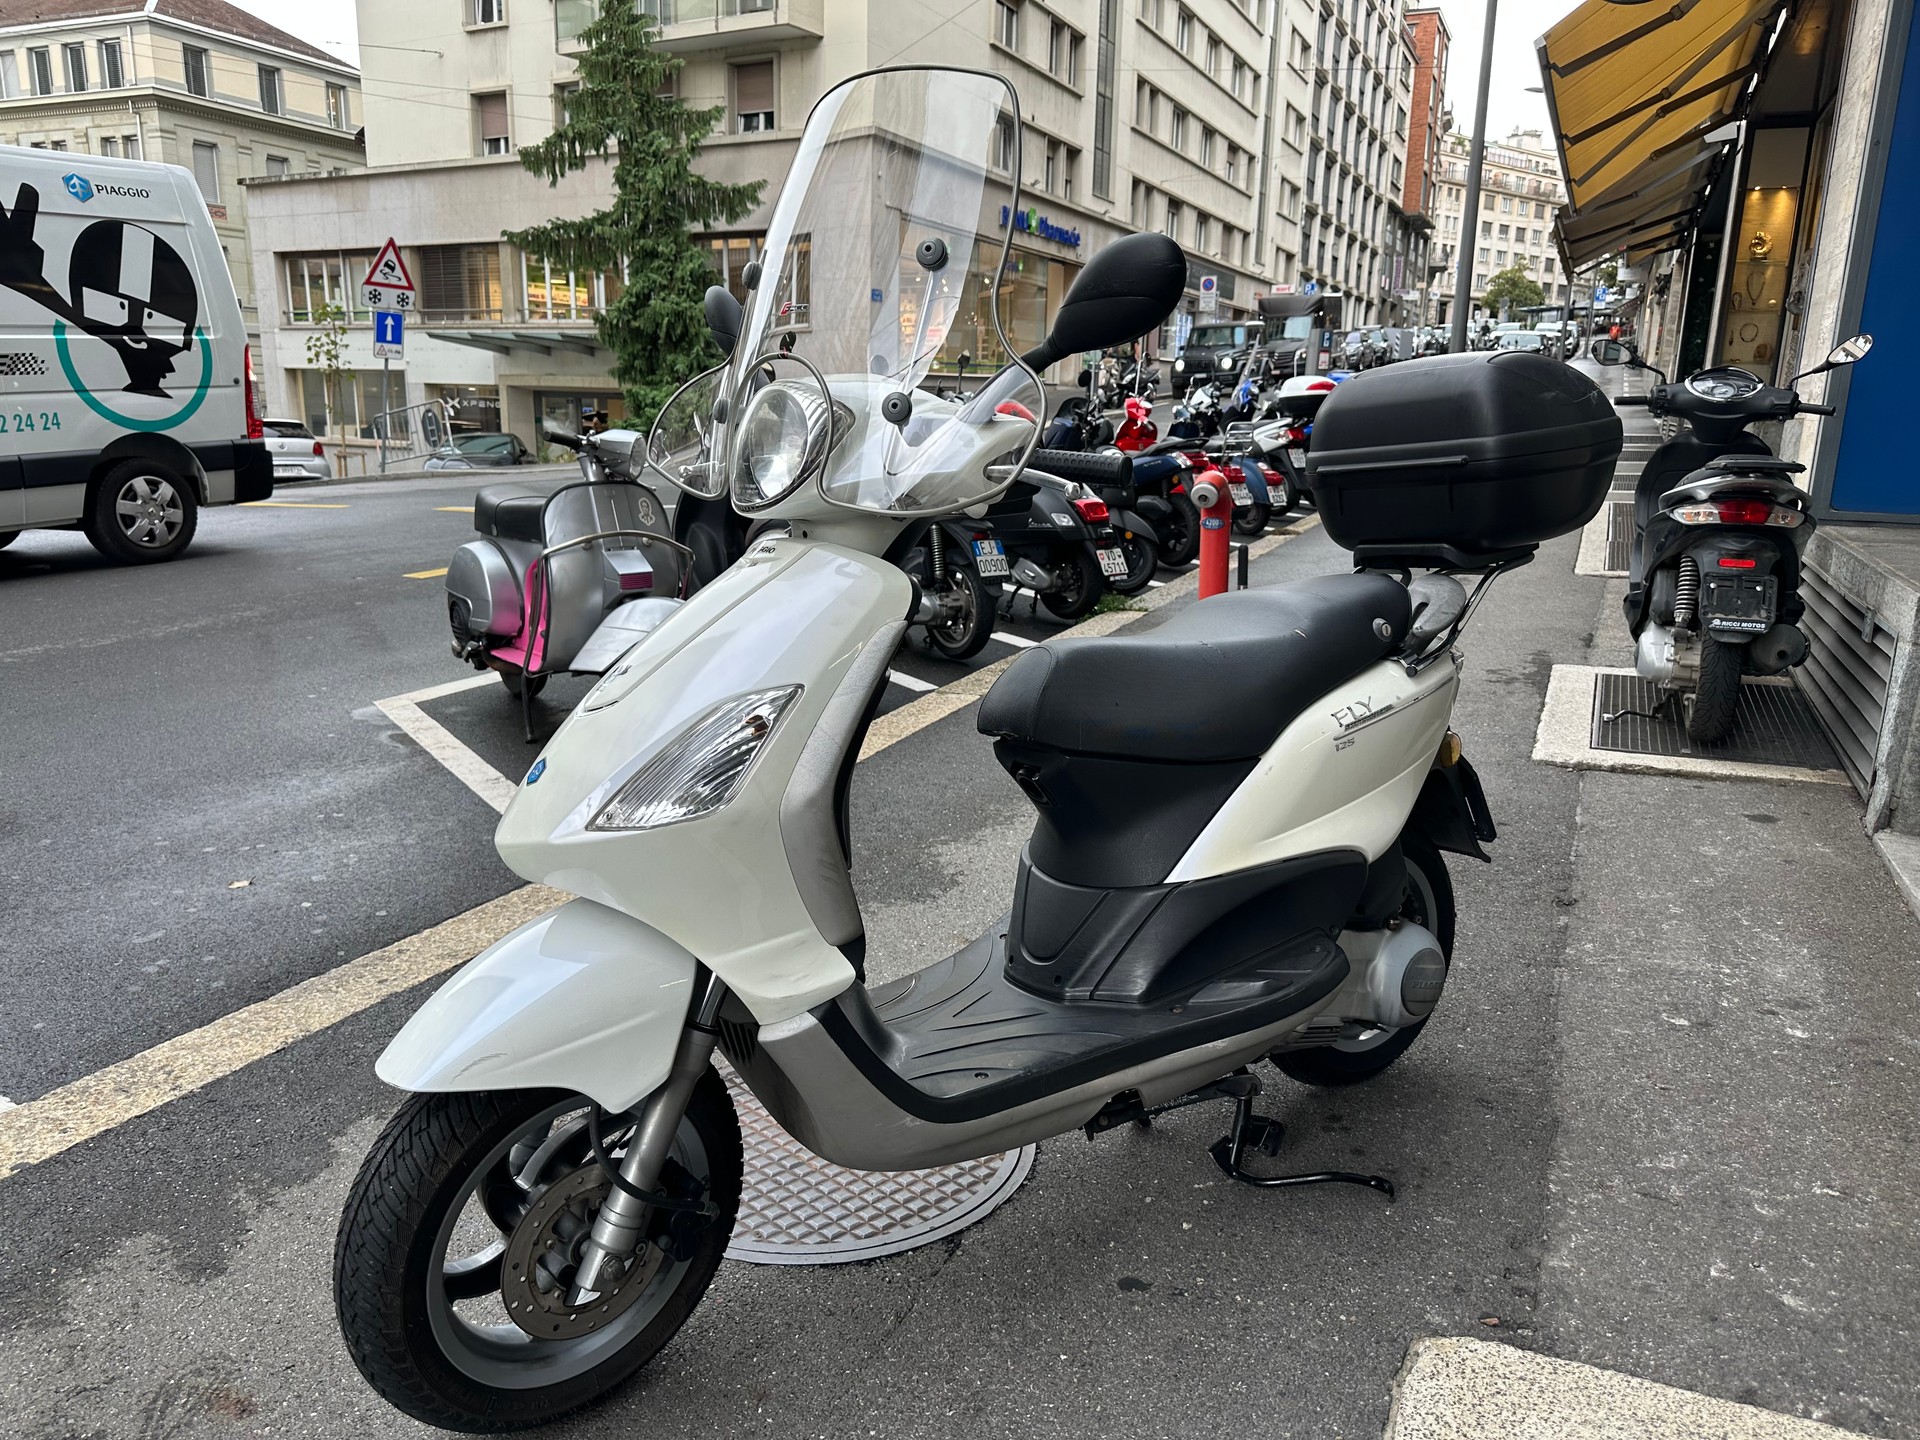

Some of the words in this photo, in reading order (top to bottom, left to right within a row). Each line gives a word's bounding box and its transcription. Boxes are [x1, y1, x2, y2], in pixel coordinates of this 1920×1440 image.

[94, 184, 150, 199] PIAGGIO
[1002, 205, 1031, 232] BNU
[1039, 216, 1080, 247] Pharmacie
[13, 413, 35, 432] 24
[40, 412, 61, 431] 24
[980, 541, 994, 555] EJ
[1104, 550, 1117, 561] VD
[979, 558, 1008, 574] 00900
[1103, 561, 1127, 574] 45711
[1721, 620, 1741, 628] RICCI
[1330, 695, 1373, 728] FLY
[1335, 737, 1356, 752] 125
